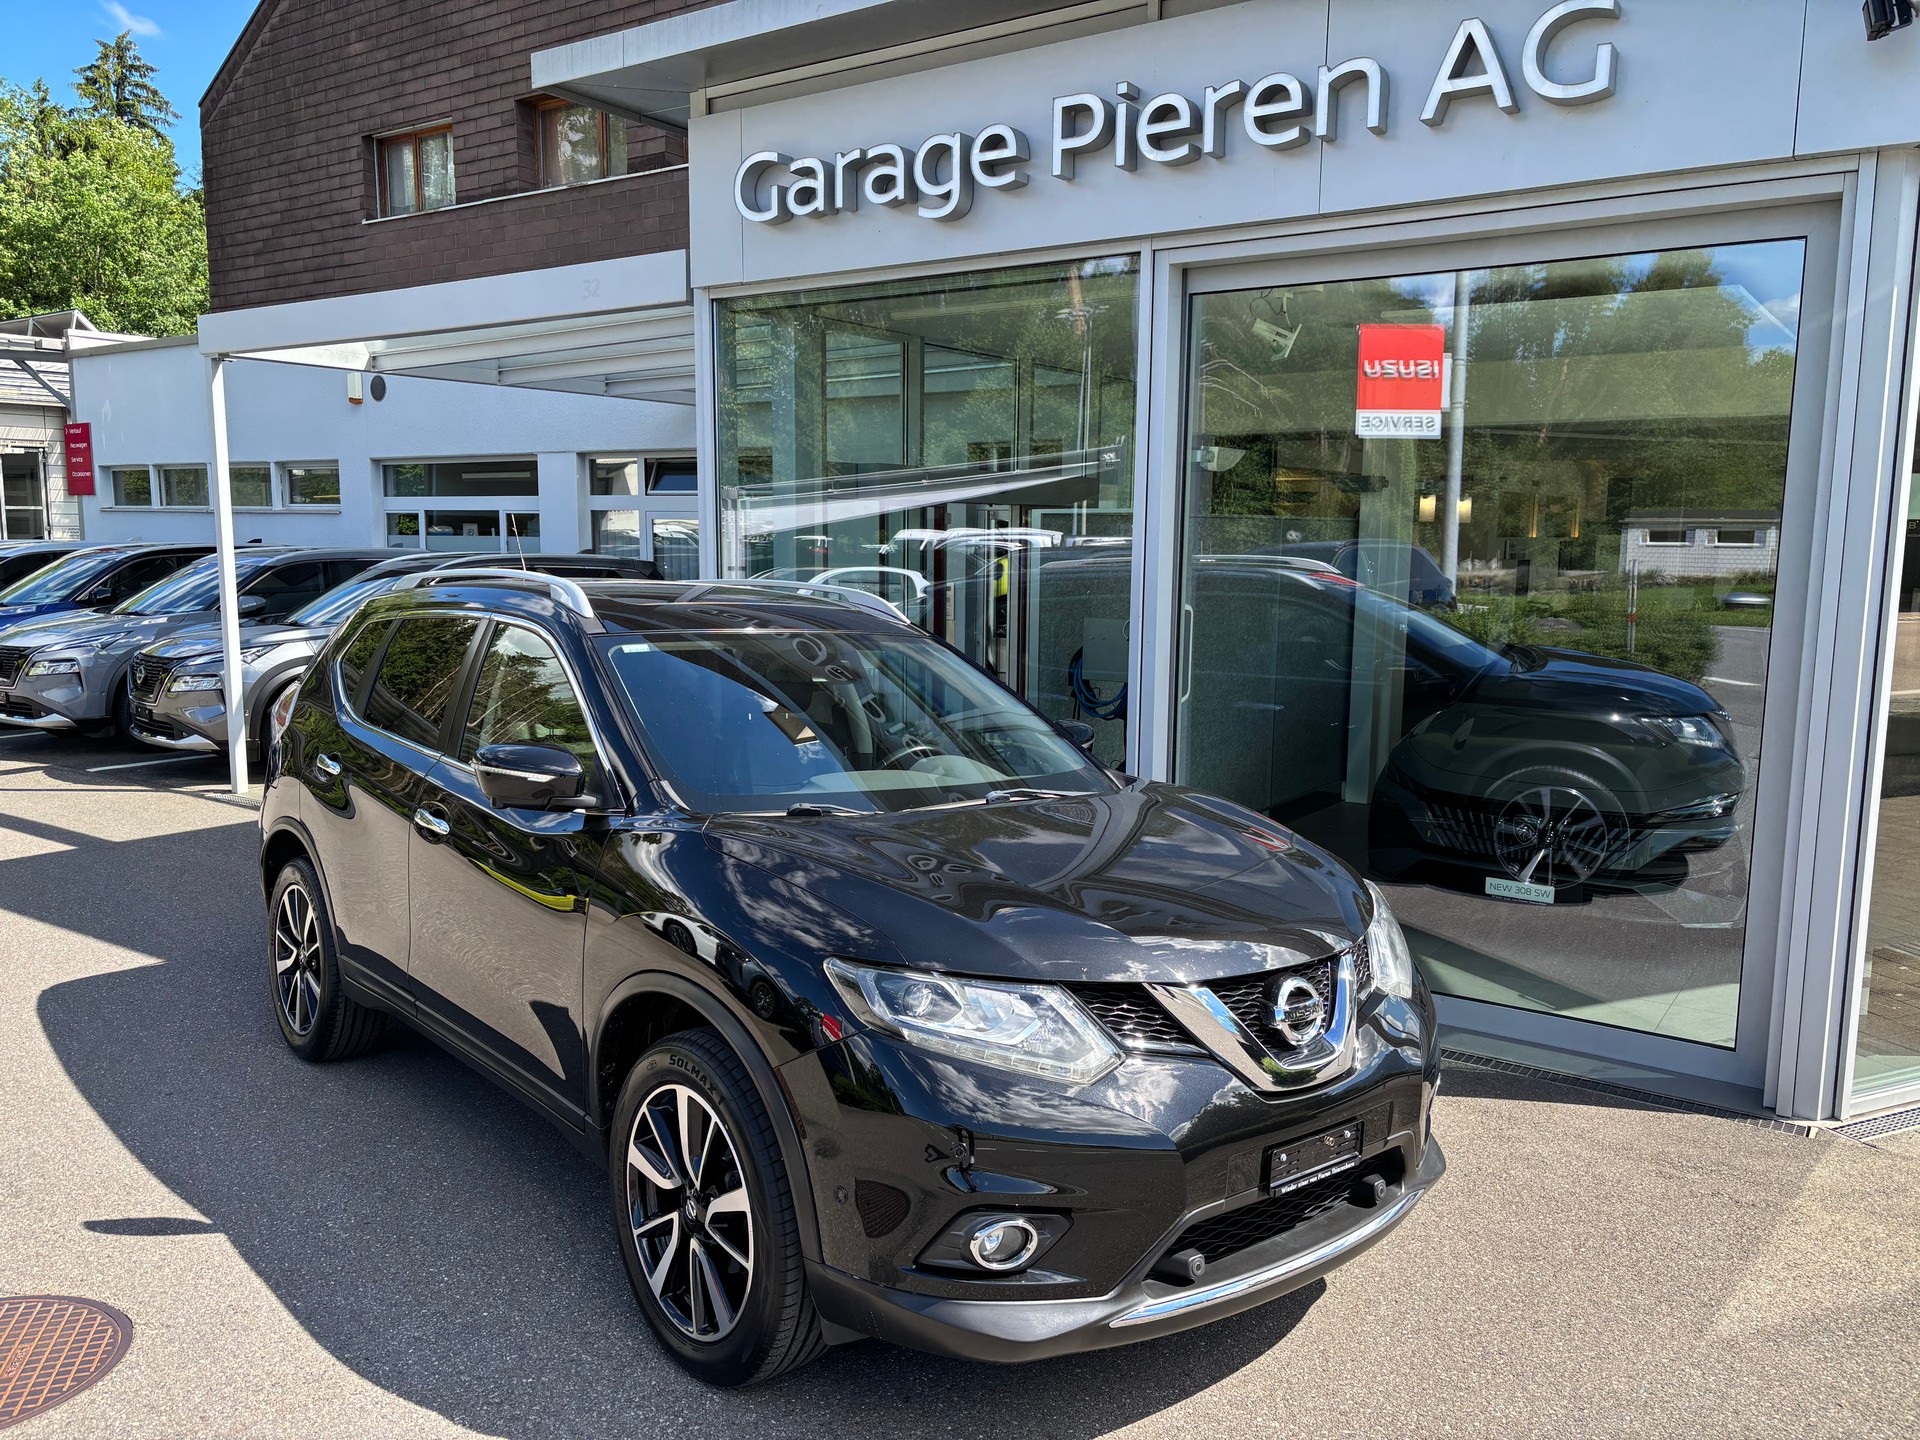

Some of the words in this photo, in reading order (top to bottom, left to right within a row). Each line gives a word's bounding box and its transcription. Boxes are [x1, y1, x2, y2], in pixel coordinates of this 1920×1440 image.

[733, 123, 1030, 225] Garage
[1051, 57, 1389, 181] Pieren
[1419, 0, 1621, 127] AG
[582, 279, 601, 299] 32
[1490, 883, 1513, 893] NEW
[1515, 886, 1532, 896] 308
[1534, 889, 1551, 898] SW
[1286, 1002, 1322, 1020] NISSAN
[668, 1054, 717, 1096] SOLMAX
[1281, 1183, 1298, 1194] Wieder
[1298, 1179, 1309, 1188] einer
